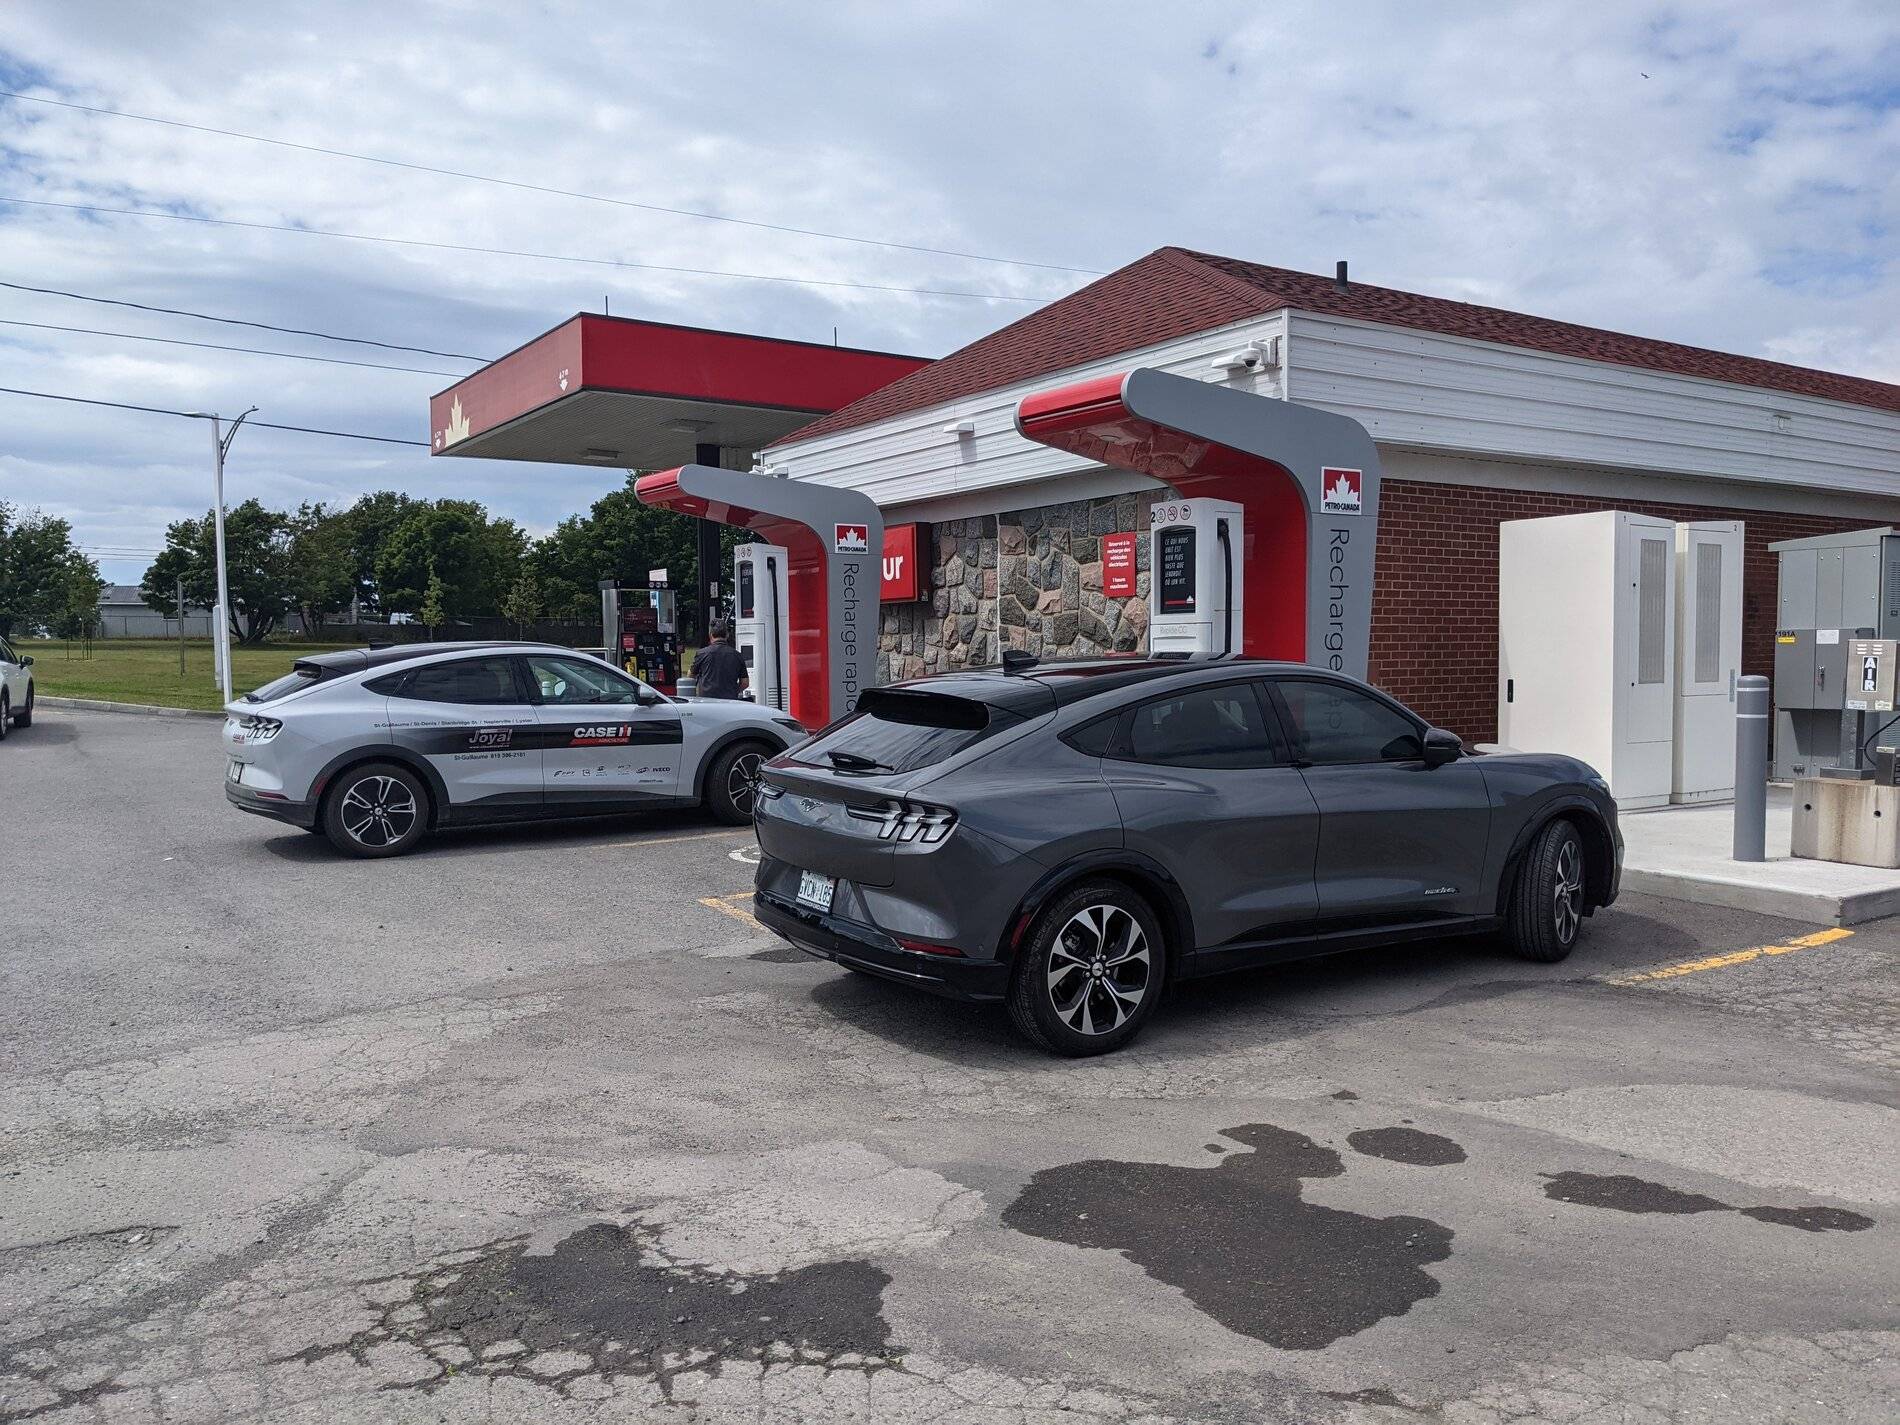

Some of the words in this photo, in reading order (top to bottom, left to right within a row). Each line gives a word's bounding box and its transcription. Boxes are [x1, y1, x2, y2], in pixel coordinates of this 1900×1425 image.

[1324, 501, 1360, 512] PETRO-CANADA
[1150, 512, 1156, 523] 2
[883, 555, 904, 581] ur
[840, 563, 860, 656] Recharge
[1324, 528, 1350, 672] Recharge
[1864, 657, 1876, 691] AIR
[468, 728, 513, 745] Joyal
[574, 727, 617, 738] CASE
